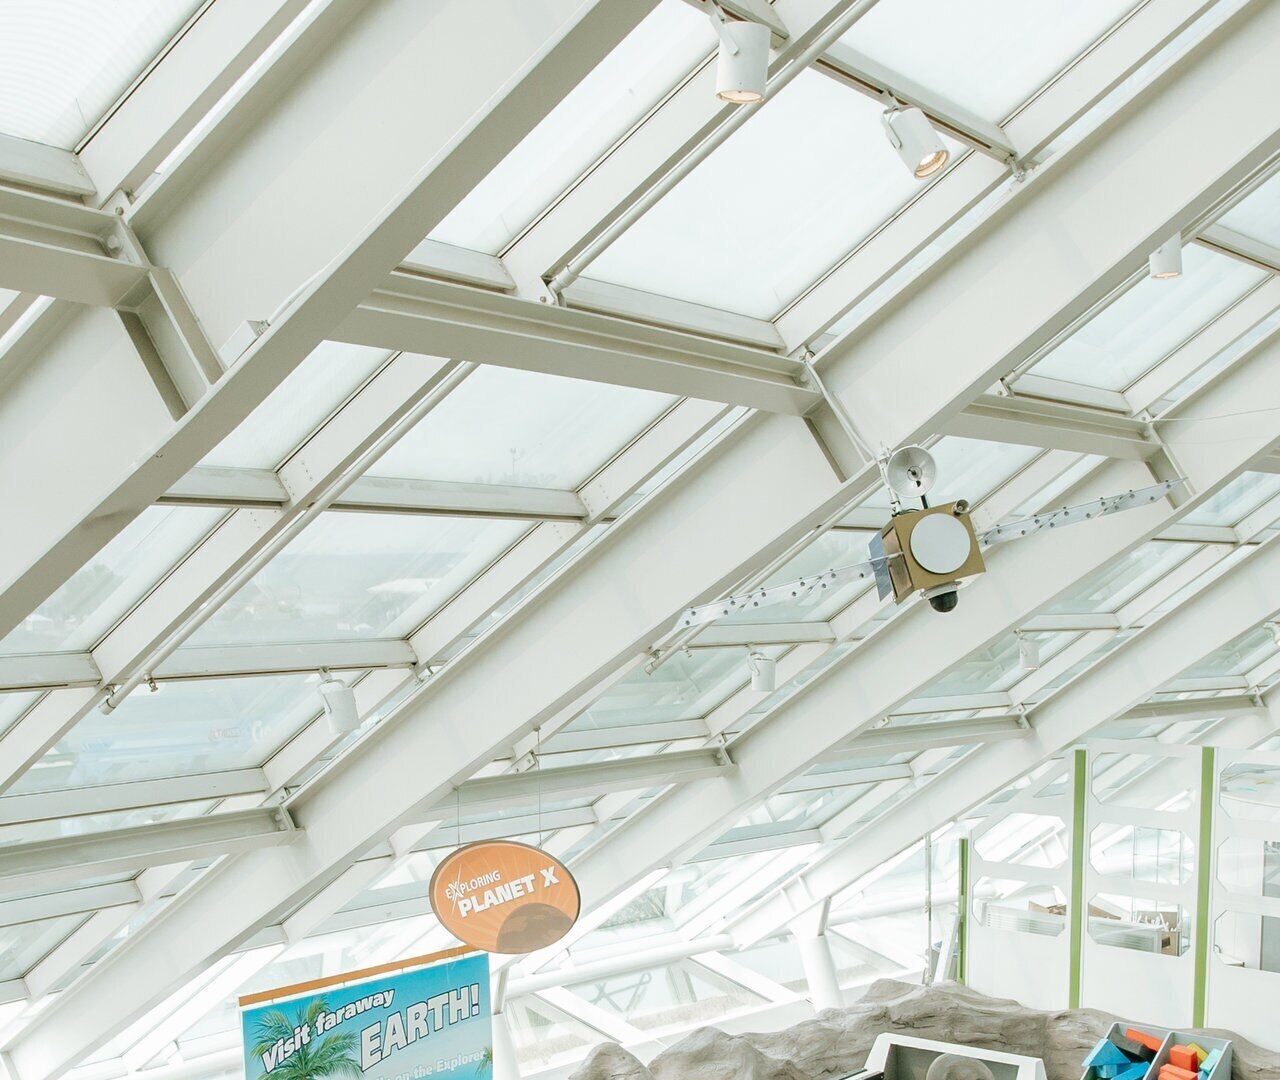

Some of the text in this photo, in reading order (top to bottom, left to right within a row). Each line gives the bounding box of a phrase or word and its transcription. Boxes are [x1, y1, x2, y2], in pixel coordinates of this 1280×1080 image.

[445, 869, 501, 901] EXPLORING
[458, 866, 560, 918] PLANET X
[261, 988, 396, 1074] Visit faraway
[361, 983, 480, 1073] EARTH!
[414, 1064, 433, 1079] the
[436, 1049, 485, 1073] Explorer
